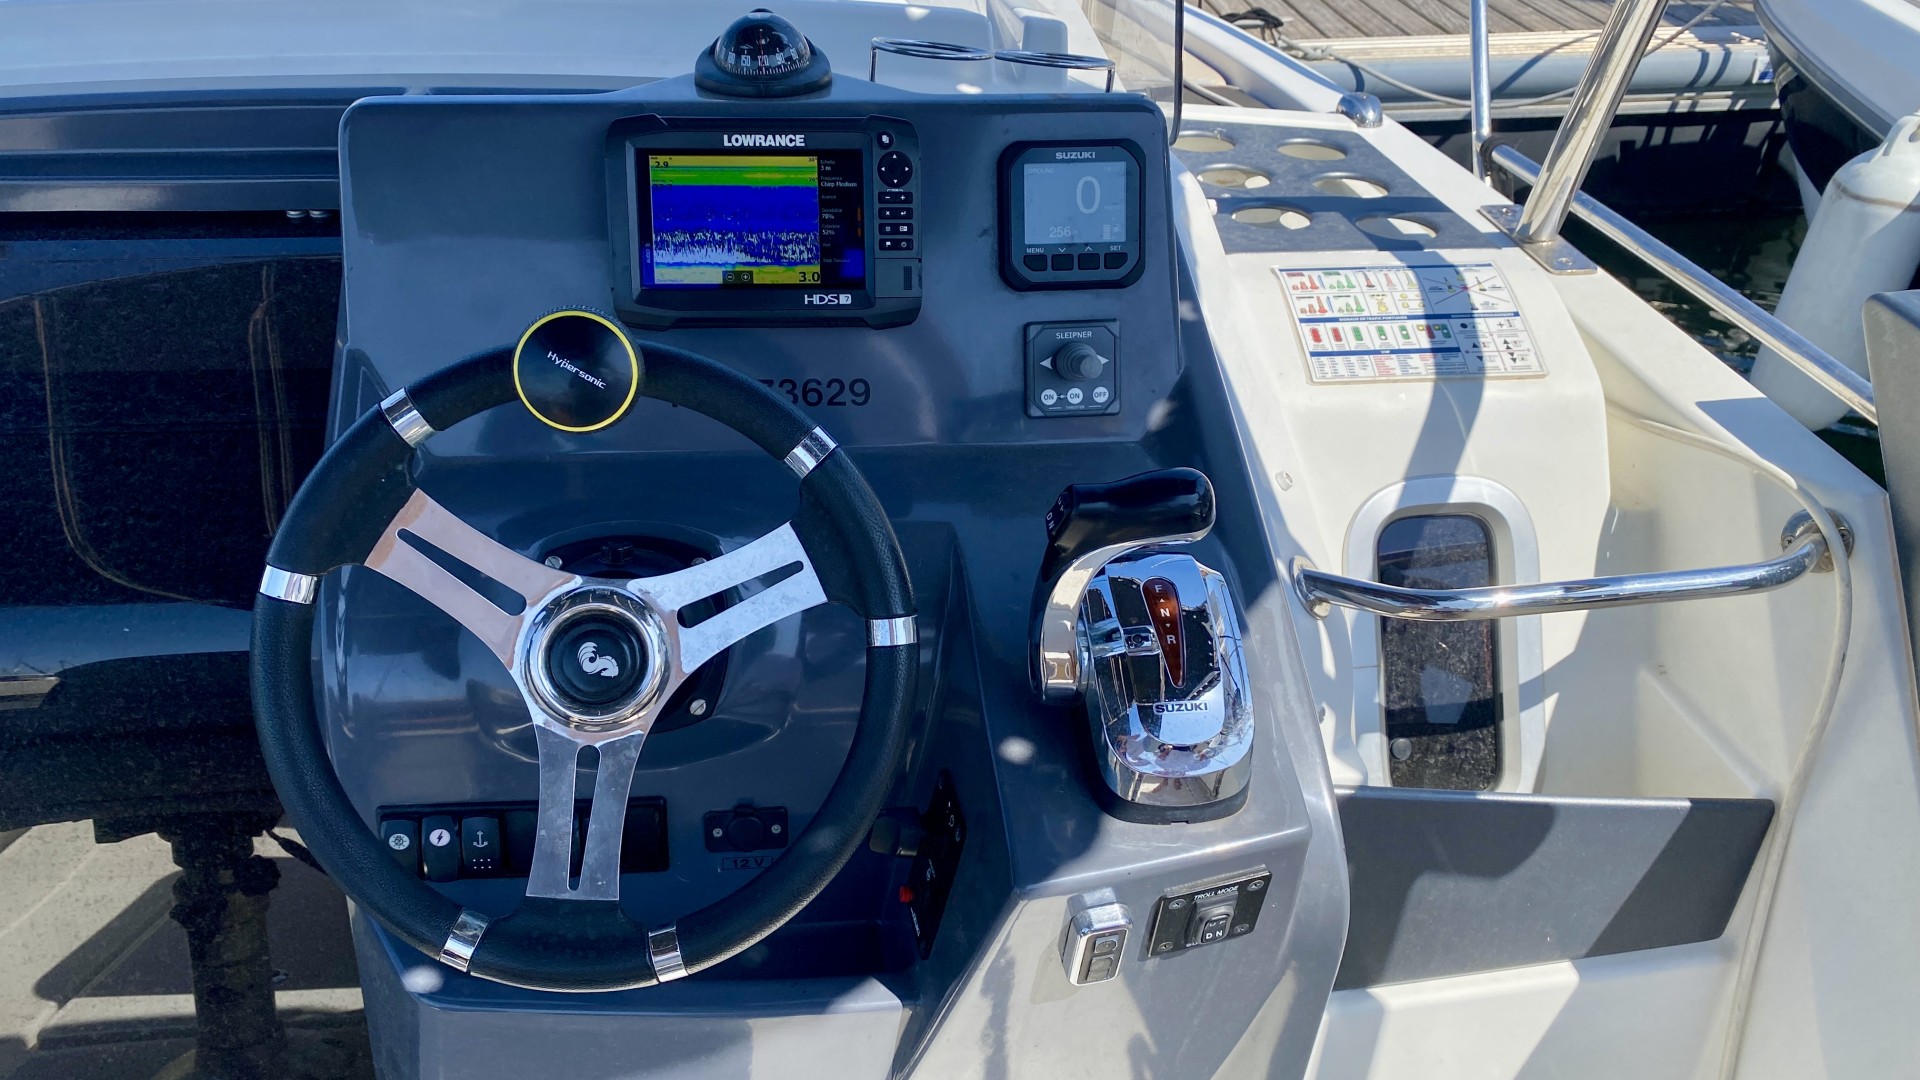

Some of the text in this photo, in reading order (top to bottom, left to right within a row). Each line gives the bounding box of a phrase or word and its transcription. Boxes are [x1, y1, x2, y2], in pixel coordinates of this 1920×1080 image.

[723, 134, 805, 147] LOWRANCE
[1056, 151, 1096, 159] SUZUKI
[1076, 176, 1101, 214] 0
[1049, 226, 1072, 238] 256
[798, 271, 820, 283] 3.0
[804, 294, 838, 305] HDS
[1056, 331, 1092, 339] SLEIPNER
[1154, 584, 1163, 593] F
[1160, 608, 1171, 618] N
[1166, 634, 1177, 645] R
[1155, 702, 1209, 713] SUZUKI
[730, 857, 765, 868] 12 V
[1194, 885, 1239, 900] TROLL MODE
